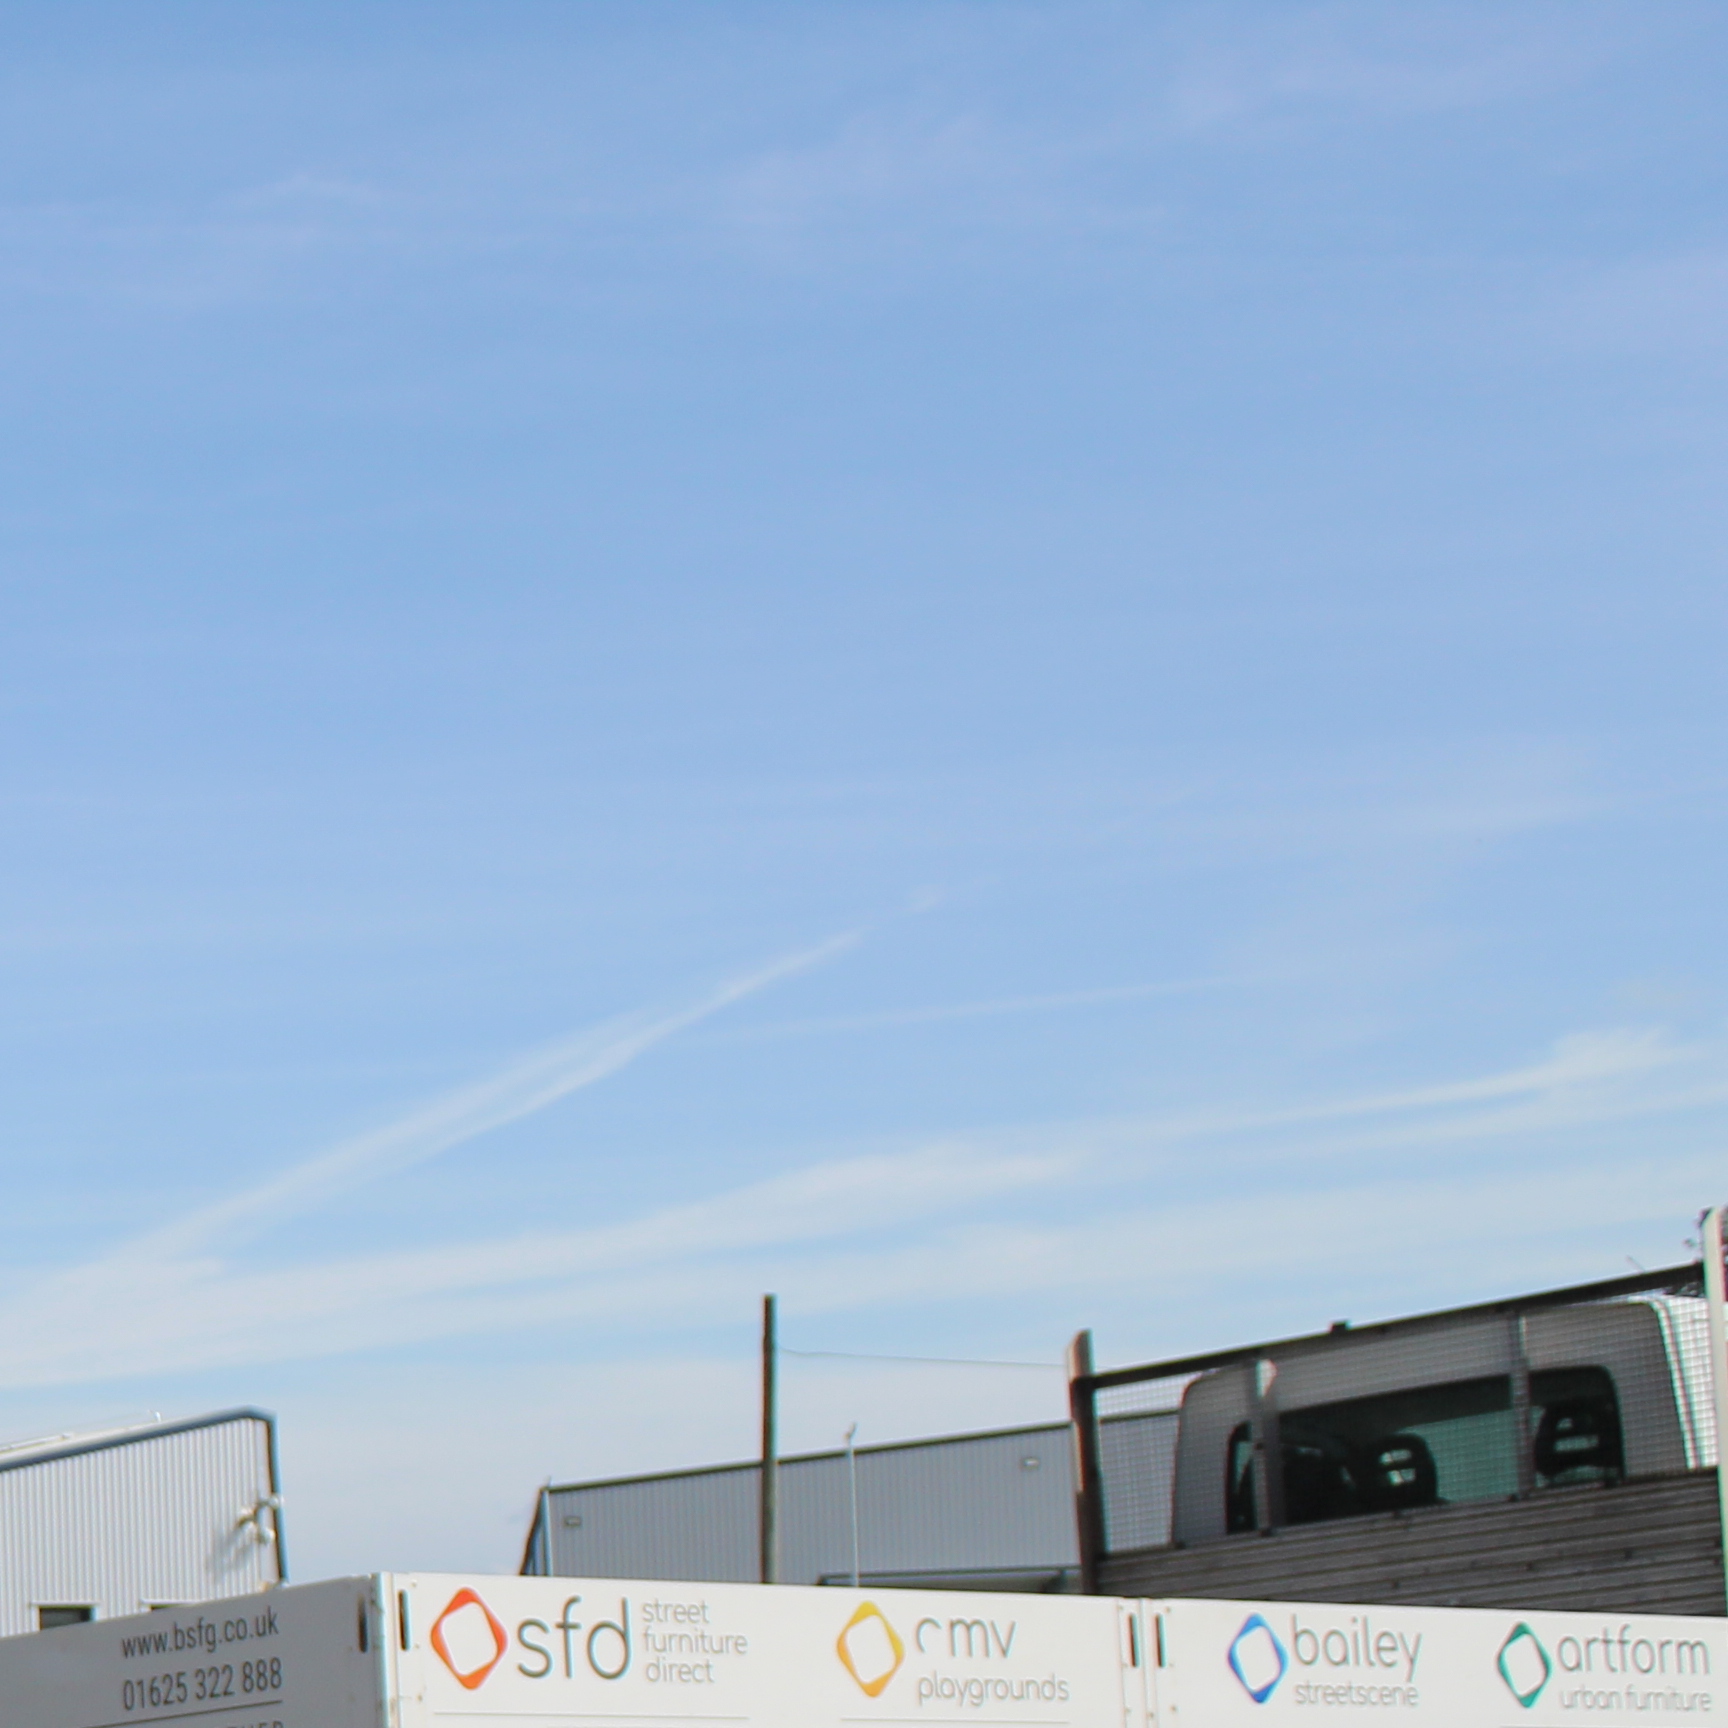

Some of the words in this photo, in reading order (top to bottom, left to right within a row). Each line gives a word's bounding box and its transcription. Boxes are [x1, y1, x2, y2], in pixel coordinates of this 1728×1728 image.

[641, 1599, 709, 1624] street
[122, 1605, 279, 1659] www.bsfg.co.uk
[517, 1595, 631, 1679] sfd
[642, 1625, 748, 1655] furniture
[1290, 1612, 1422, 1683] bailey
[1556, 1623, 1710, 1675] artform
[123, 1671, 188, 1711] 01625
[195, 1663, 235, 1700] 322
[242, 1656, 282, 1693] 888
[645, 1656, 715, 1683] direct
[917, 1669, 1070, 1708] playgrounds
[1294, 1680, 1419, 1706] streetscene
[1560, 1684, 1621, 1710] urban
[1625, 1684, 1712, 1712] furniture
